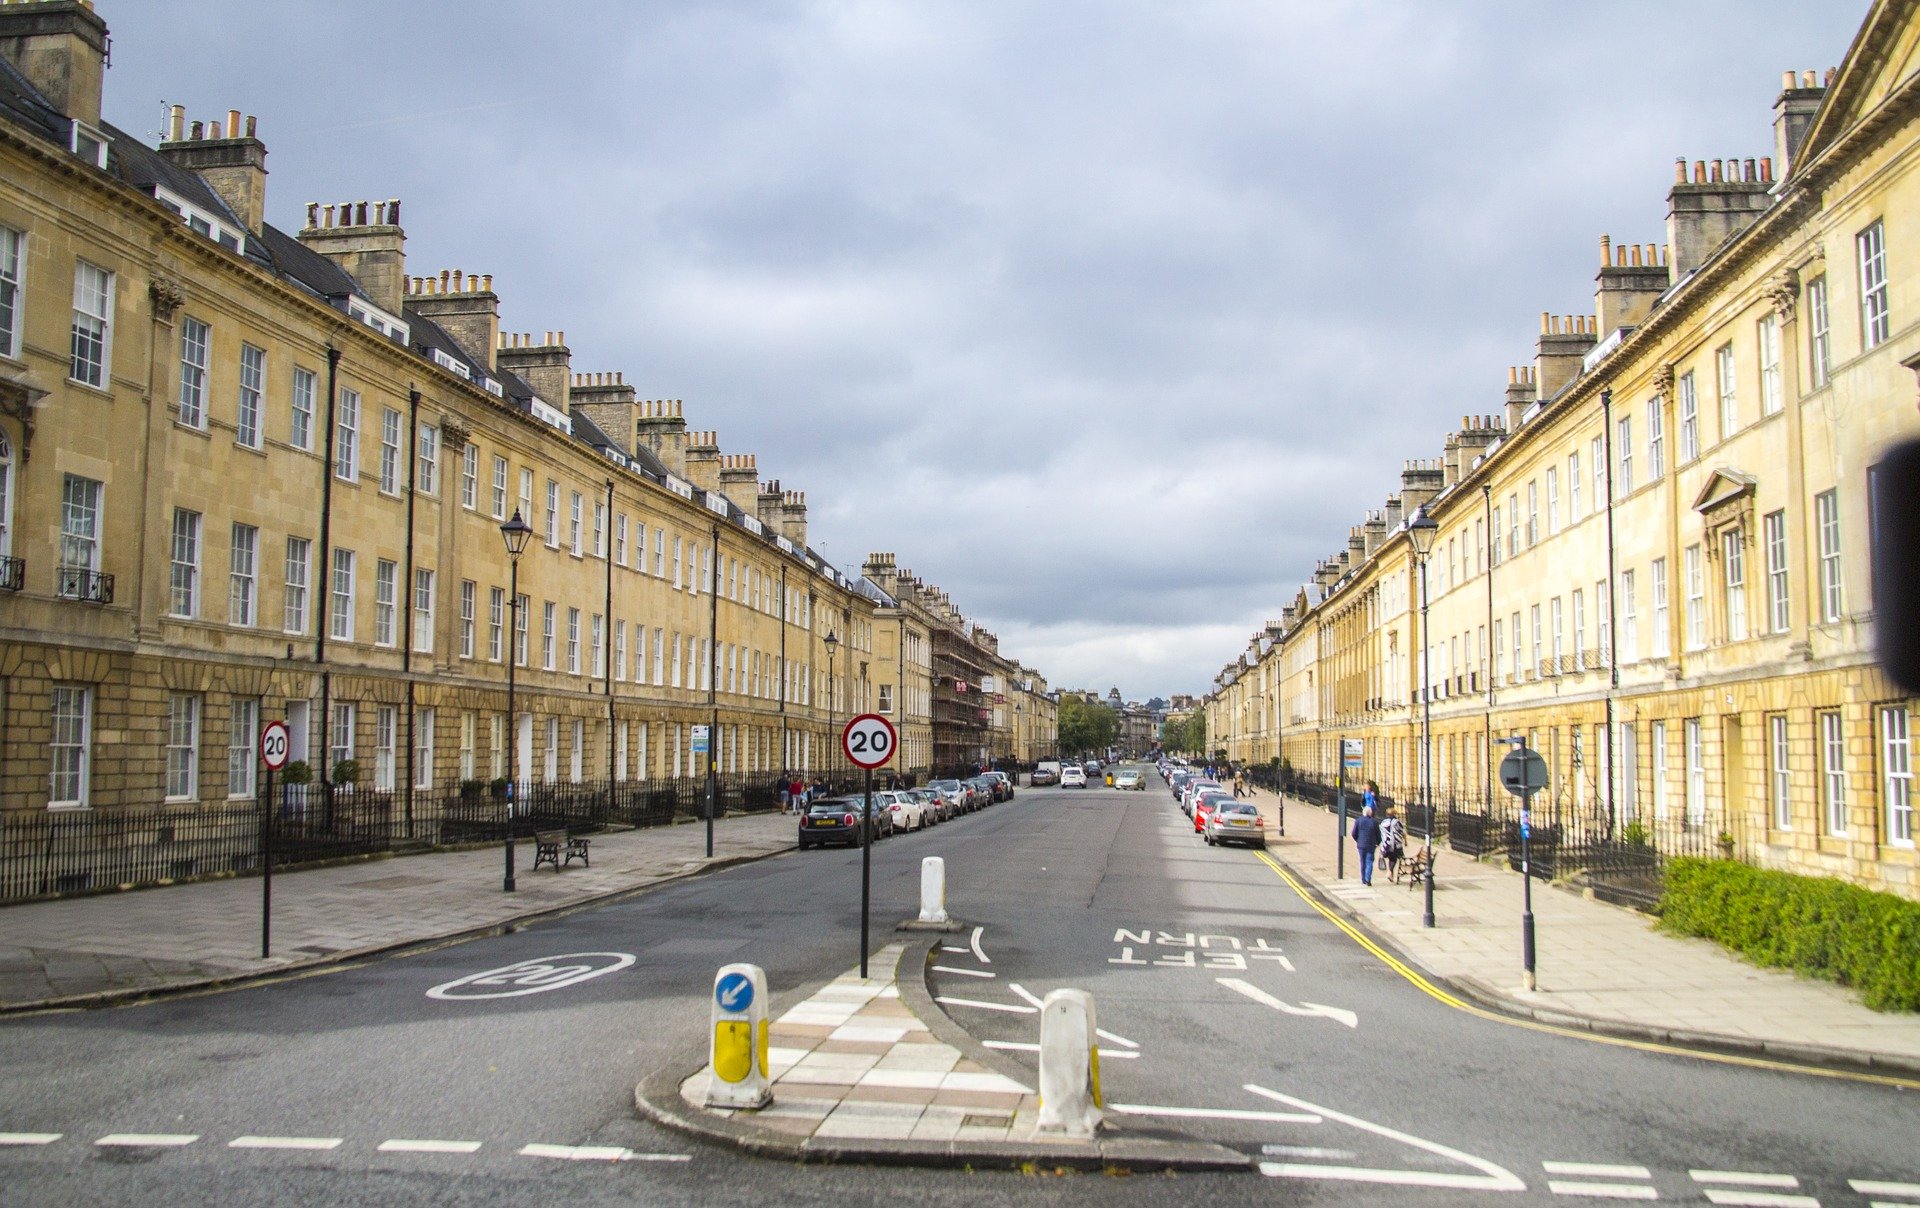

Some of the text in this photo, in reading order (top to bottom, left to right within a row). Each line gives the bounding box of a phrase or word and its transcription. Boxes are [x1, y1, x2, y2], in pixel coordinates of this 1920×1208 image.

[266, 736, 285, 755] 20
[851, 730, 888, 752] 20
[1113, 928, 1283, 952] TURN
[1107, 946, 1296, 972] LEFT
[471, 964, 593, 986] 20
